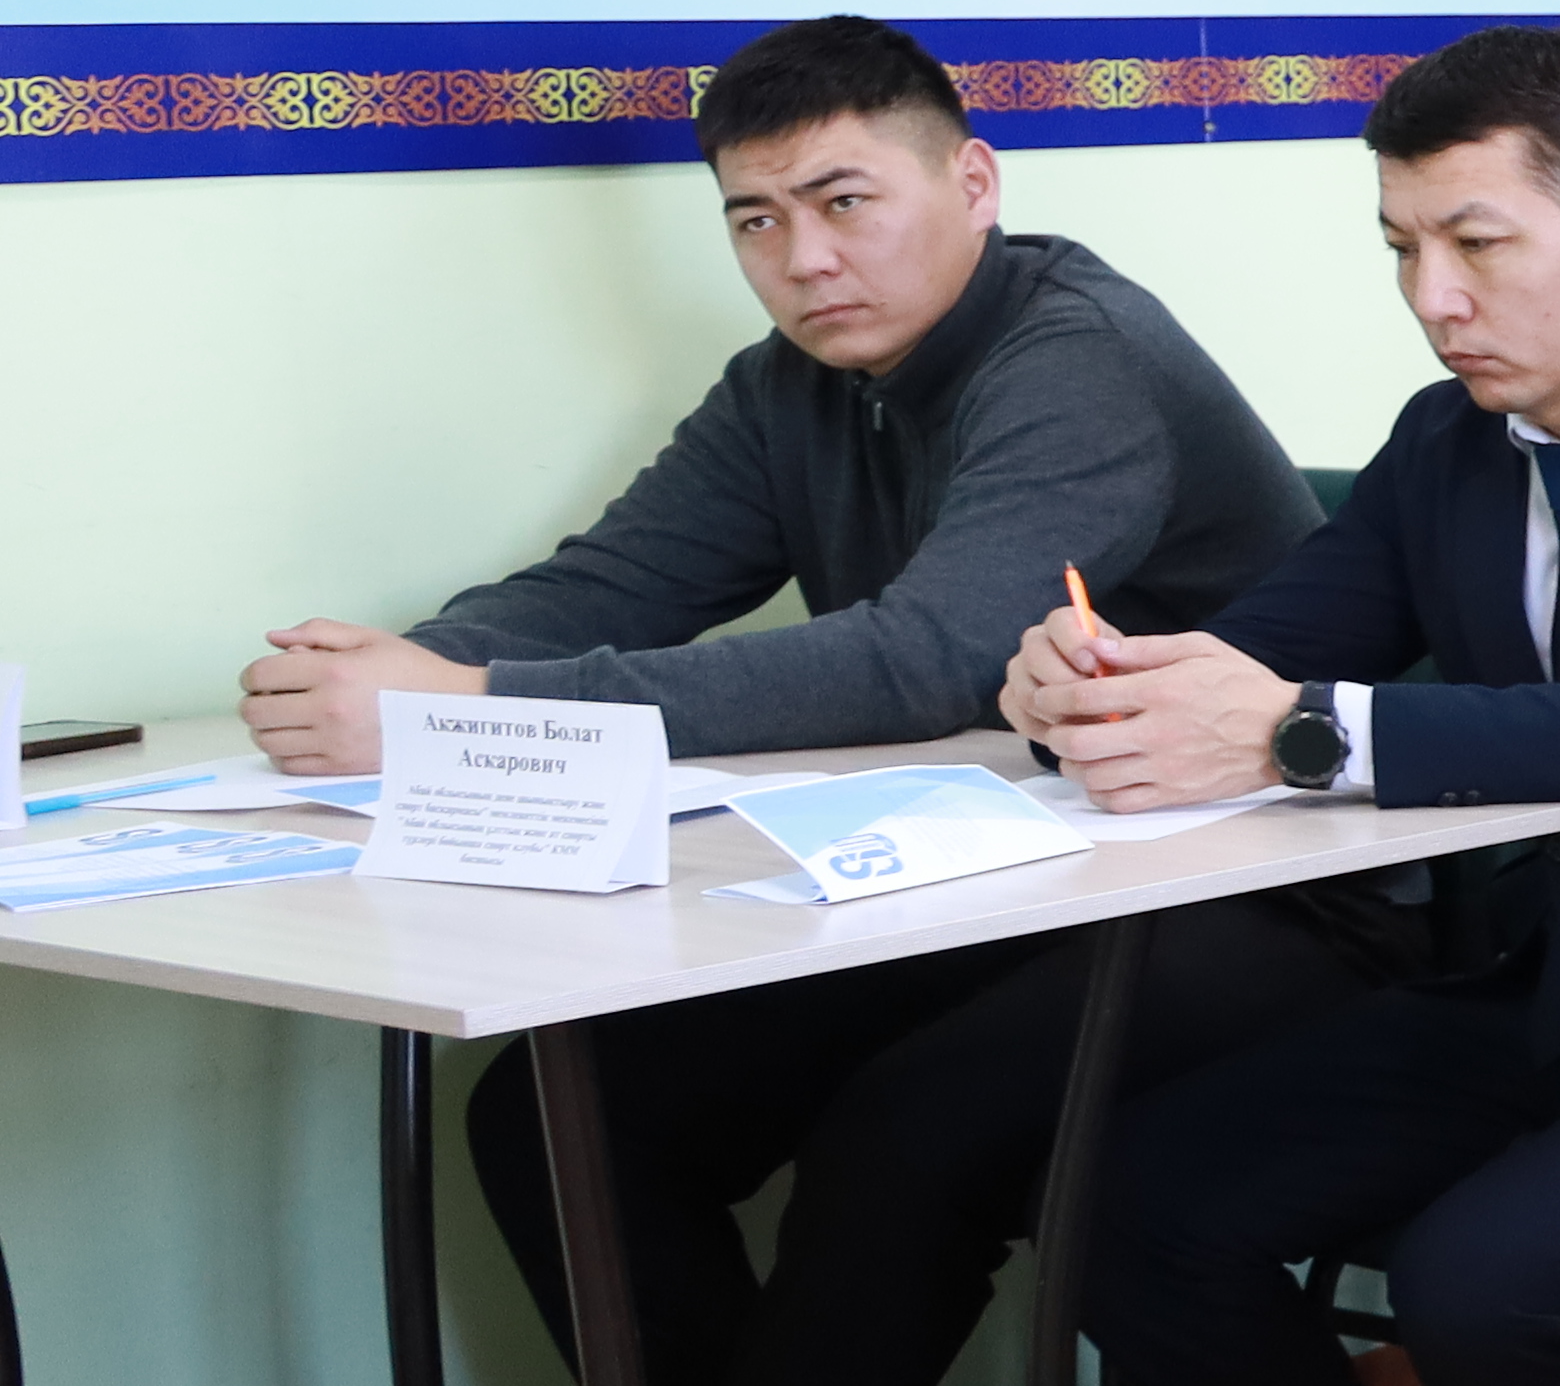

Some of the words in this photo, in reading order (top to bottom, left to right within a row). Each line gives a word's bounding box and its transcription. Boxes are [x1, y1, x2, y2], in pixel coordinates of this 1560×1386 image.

[423, 713, 537, 738] Акжигитов
[543, 720, 603, 743] Болат
[457, 749, 567, 776] Аскарович
